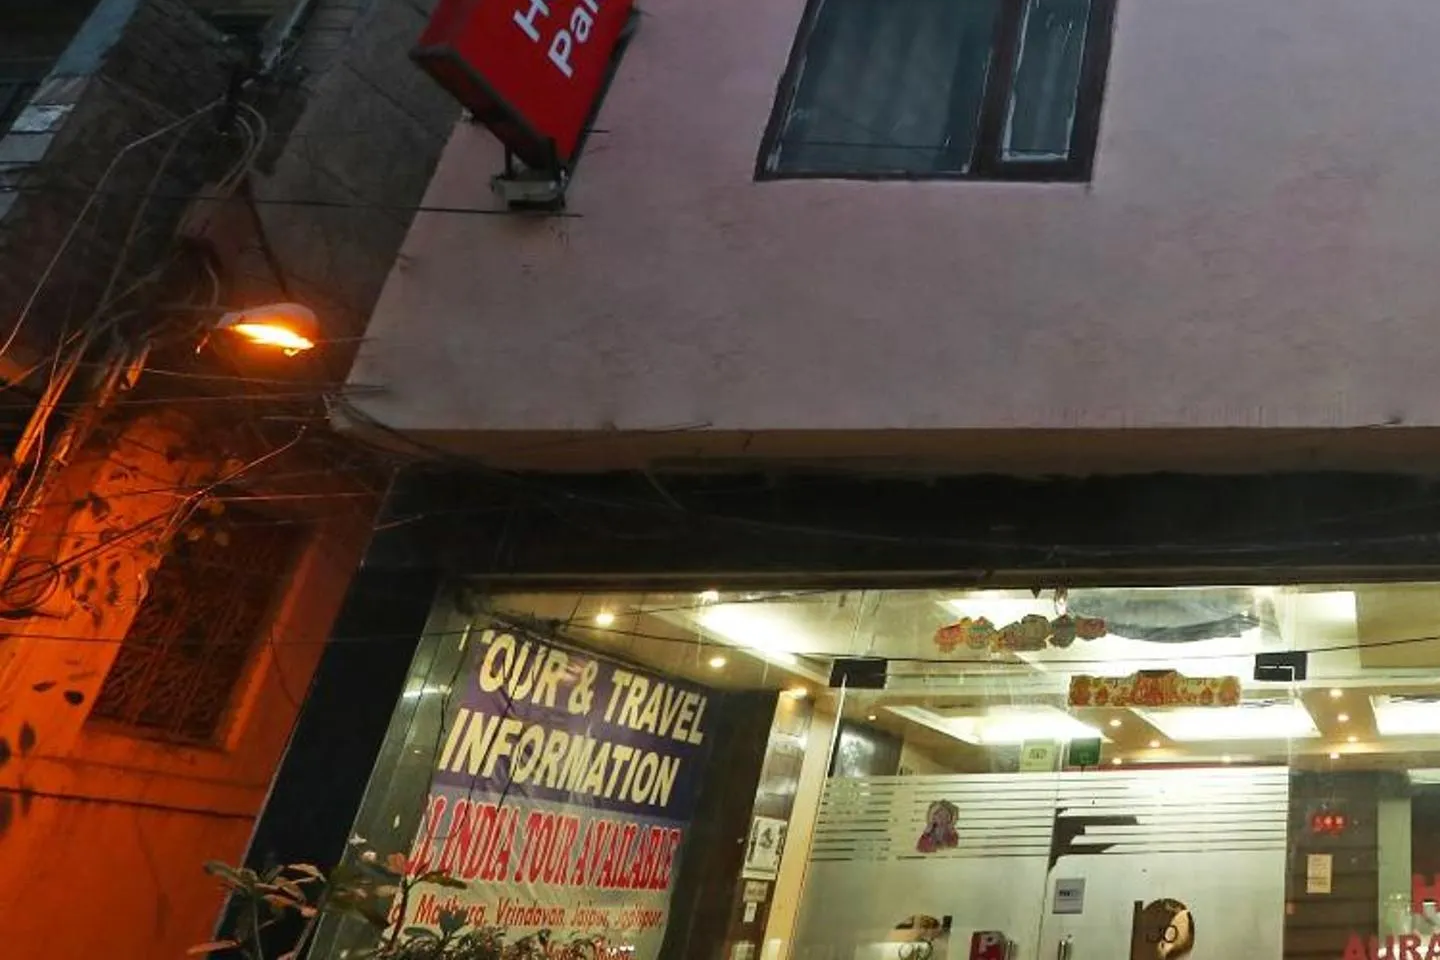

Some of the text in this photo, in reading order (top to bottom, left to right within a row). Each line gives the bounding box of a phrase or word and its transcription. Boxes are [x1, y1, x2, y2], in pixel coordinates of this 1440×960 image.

[568, 660, 600, 716] &
[604, 669, 709, 745] TRAVEL
[438, 707, 682, 808] INFORMATION
[441, 799, 522, 884] INDIA
[514, 810, 581, 888] TOUR
[574, 818, 683, 892] AVAILABLE
